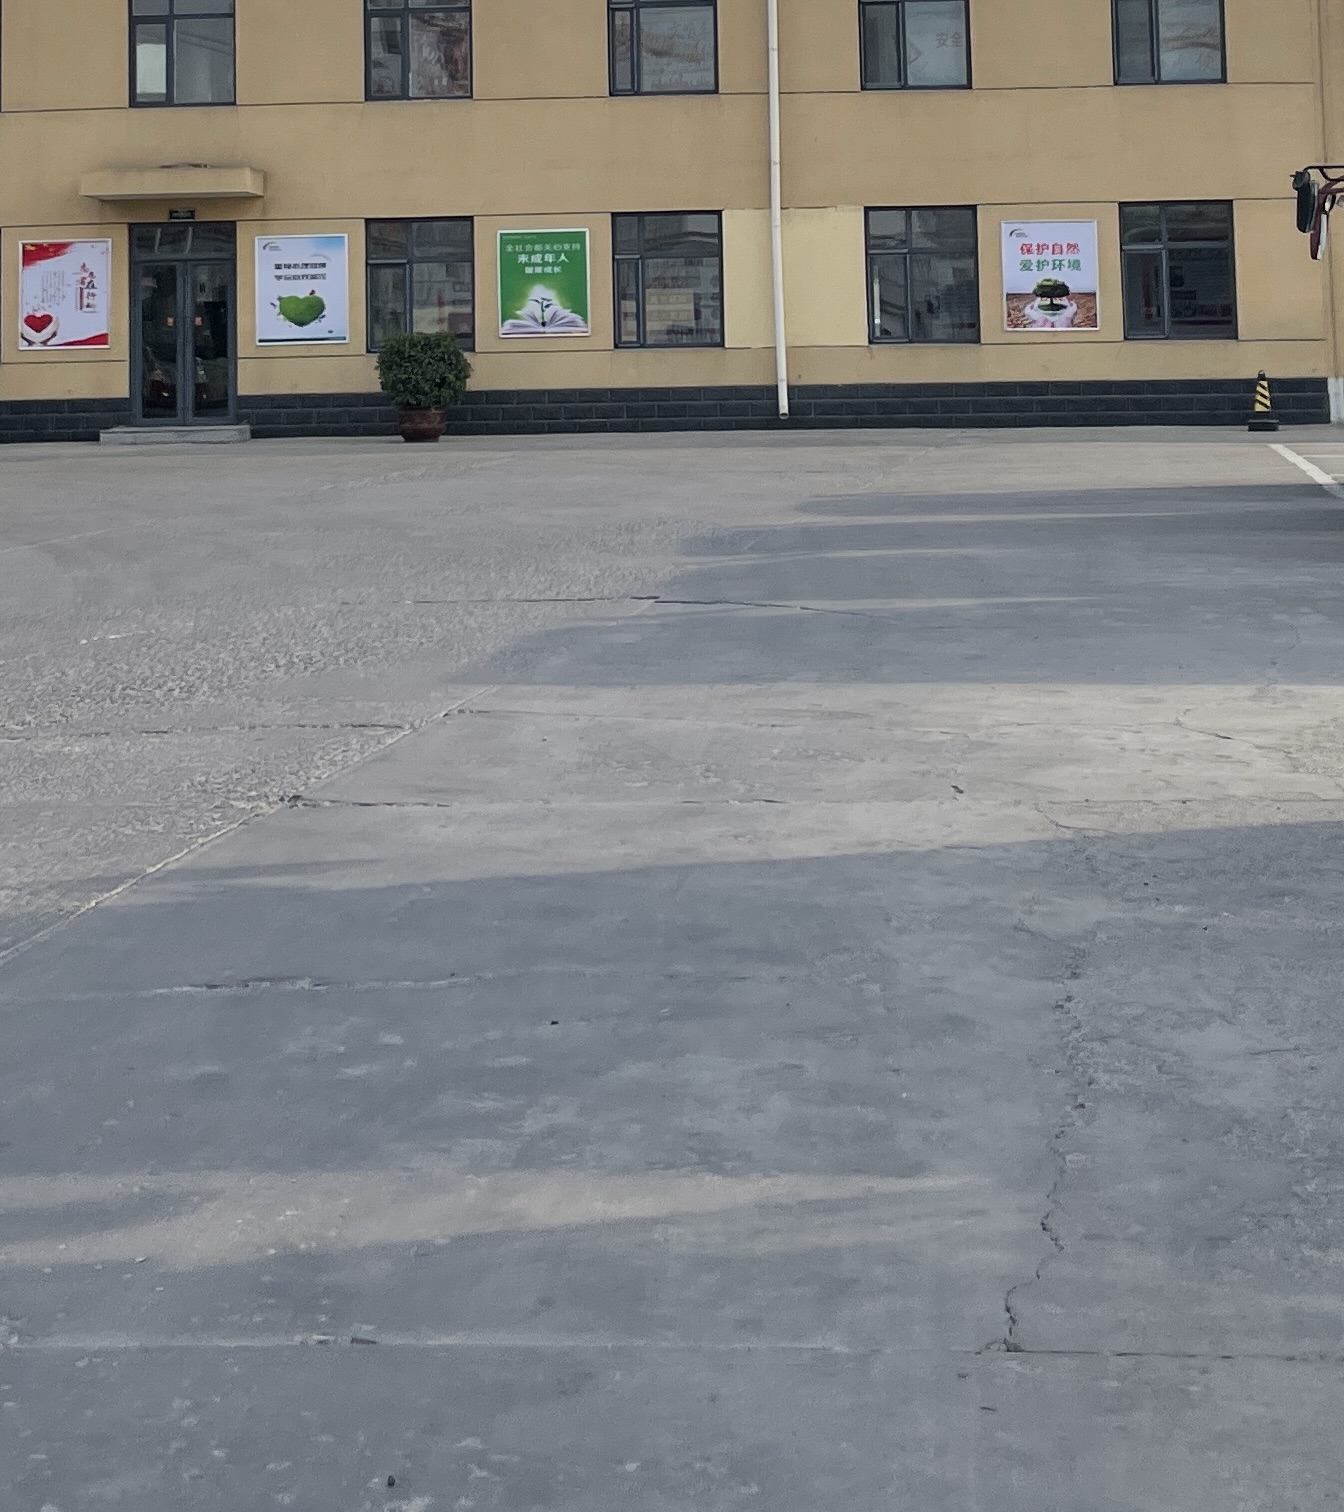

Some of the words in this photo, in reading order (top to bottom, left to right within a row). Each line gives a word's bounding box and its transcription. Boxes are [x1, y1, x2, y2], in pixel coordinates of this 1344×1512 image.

[1020, 243, 1080, 255] 保护自然
[1019, 259, 1082, 271] 爱护环境
